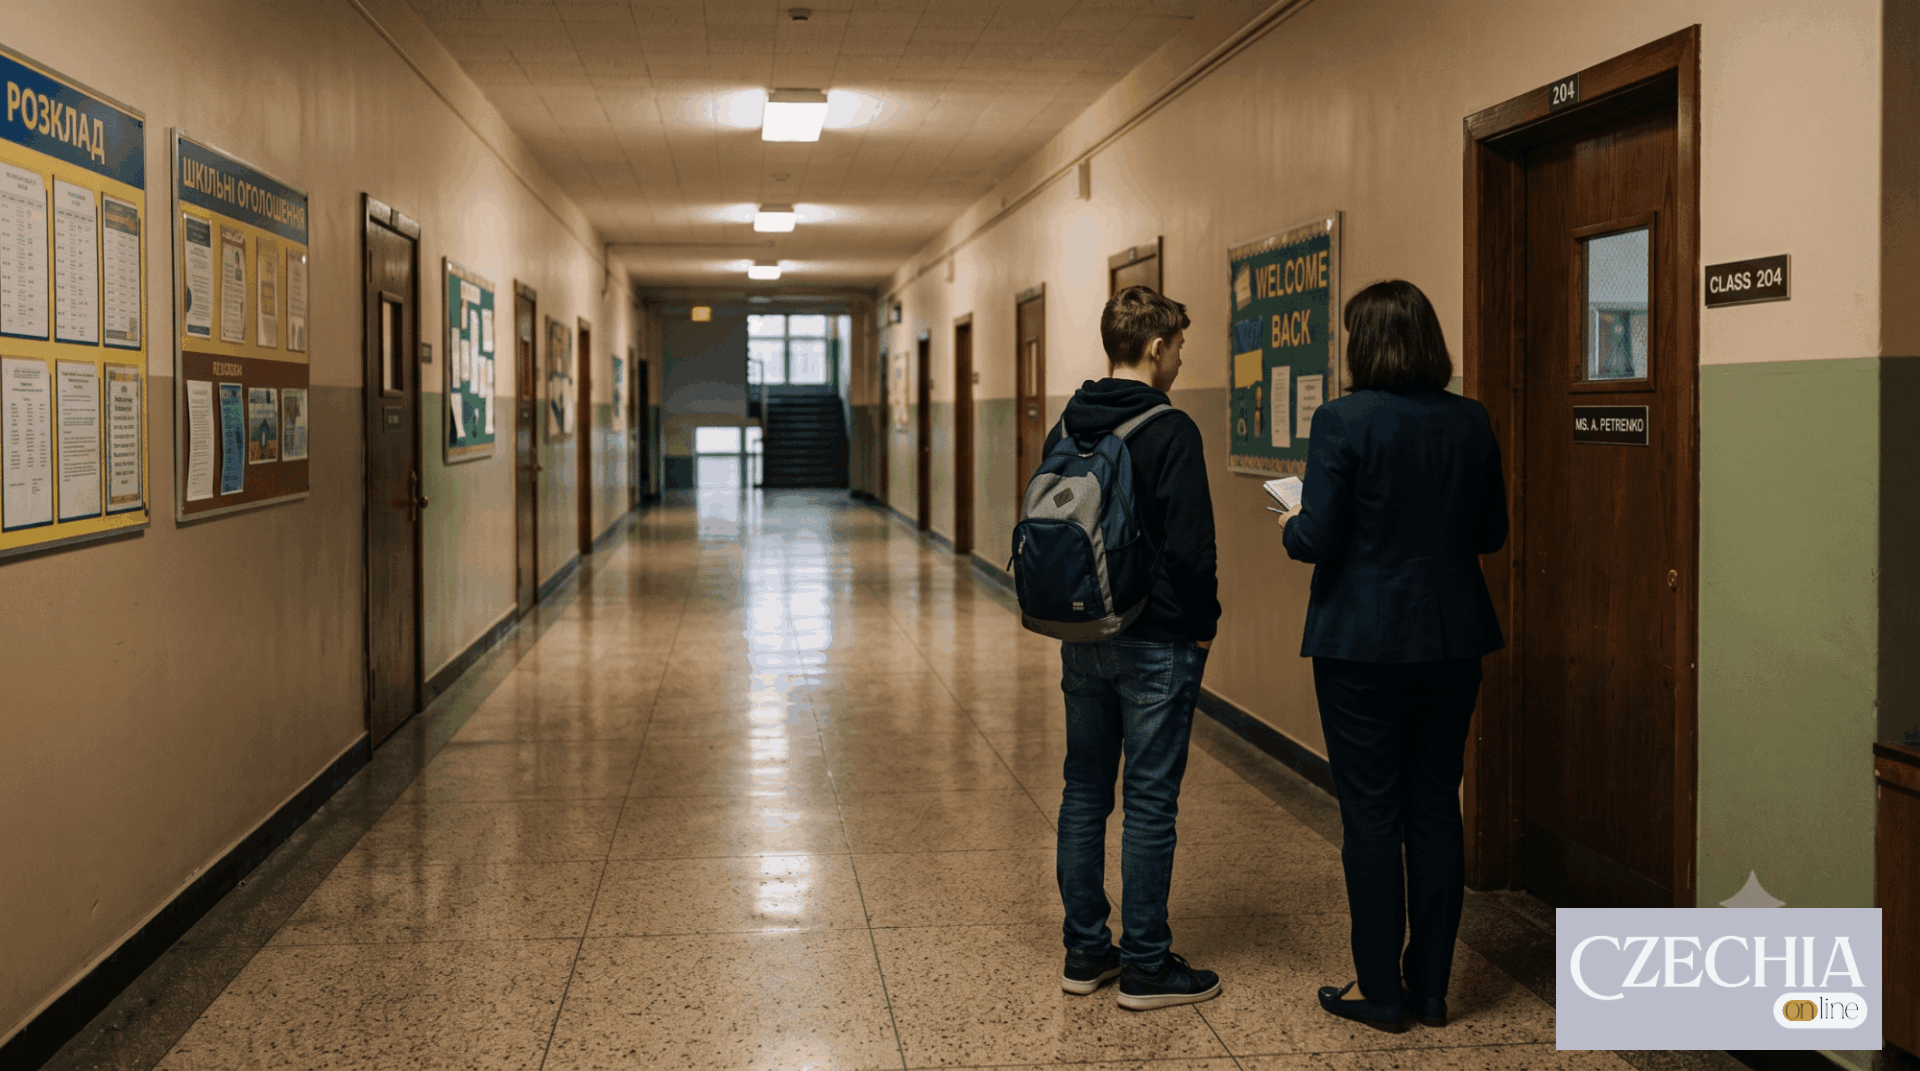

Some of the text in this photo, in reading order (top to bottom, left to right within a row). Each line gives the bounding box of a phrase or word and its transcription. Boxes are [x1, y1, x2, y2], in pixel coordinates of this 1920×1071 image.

[1553, 80, 1575, 105] 204
[7, 80, 105, 165] РОЗКЛАД
[183, 156, 305, 231] ШКІЛЬНІ ОГОЛОШЕННЯ
[1255, 249, 1328, 300] WELCOME
[1709, 266, 1783, 294] CLASS 204
[1271, 308, 1312, 349] BACK
[1575, 417, 1645, 432] MS. A. PETRENKO
